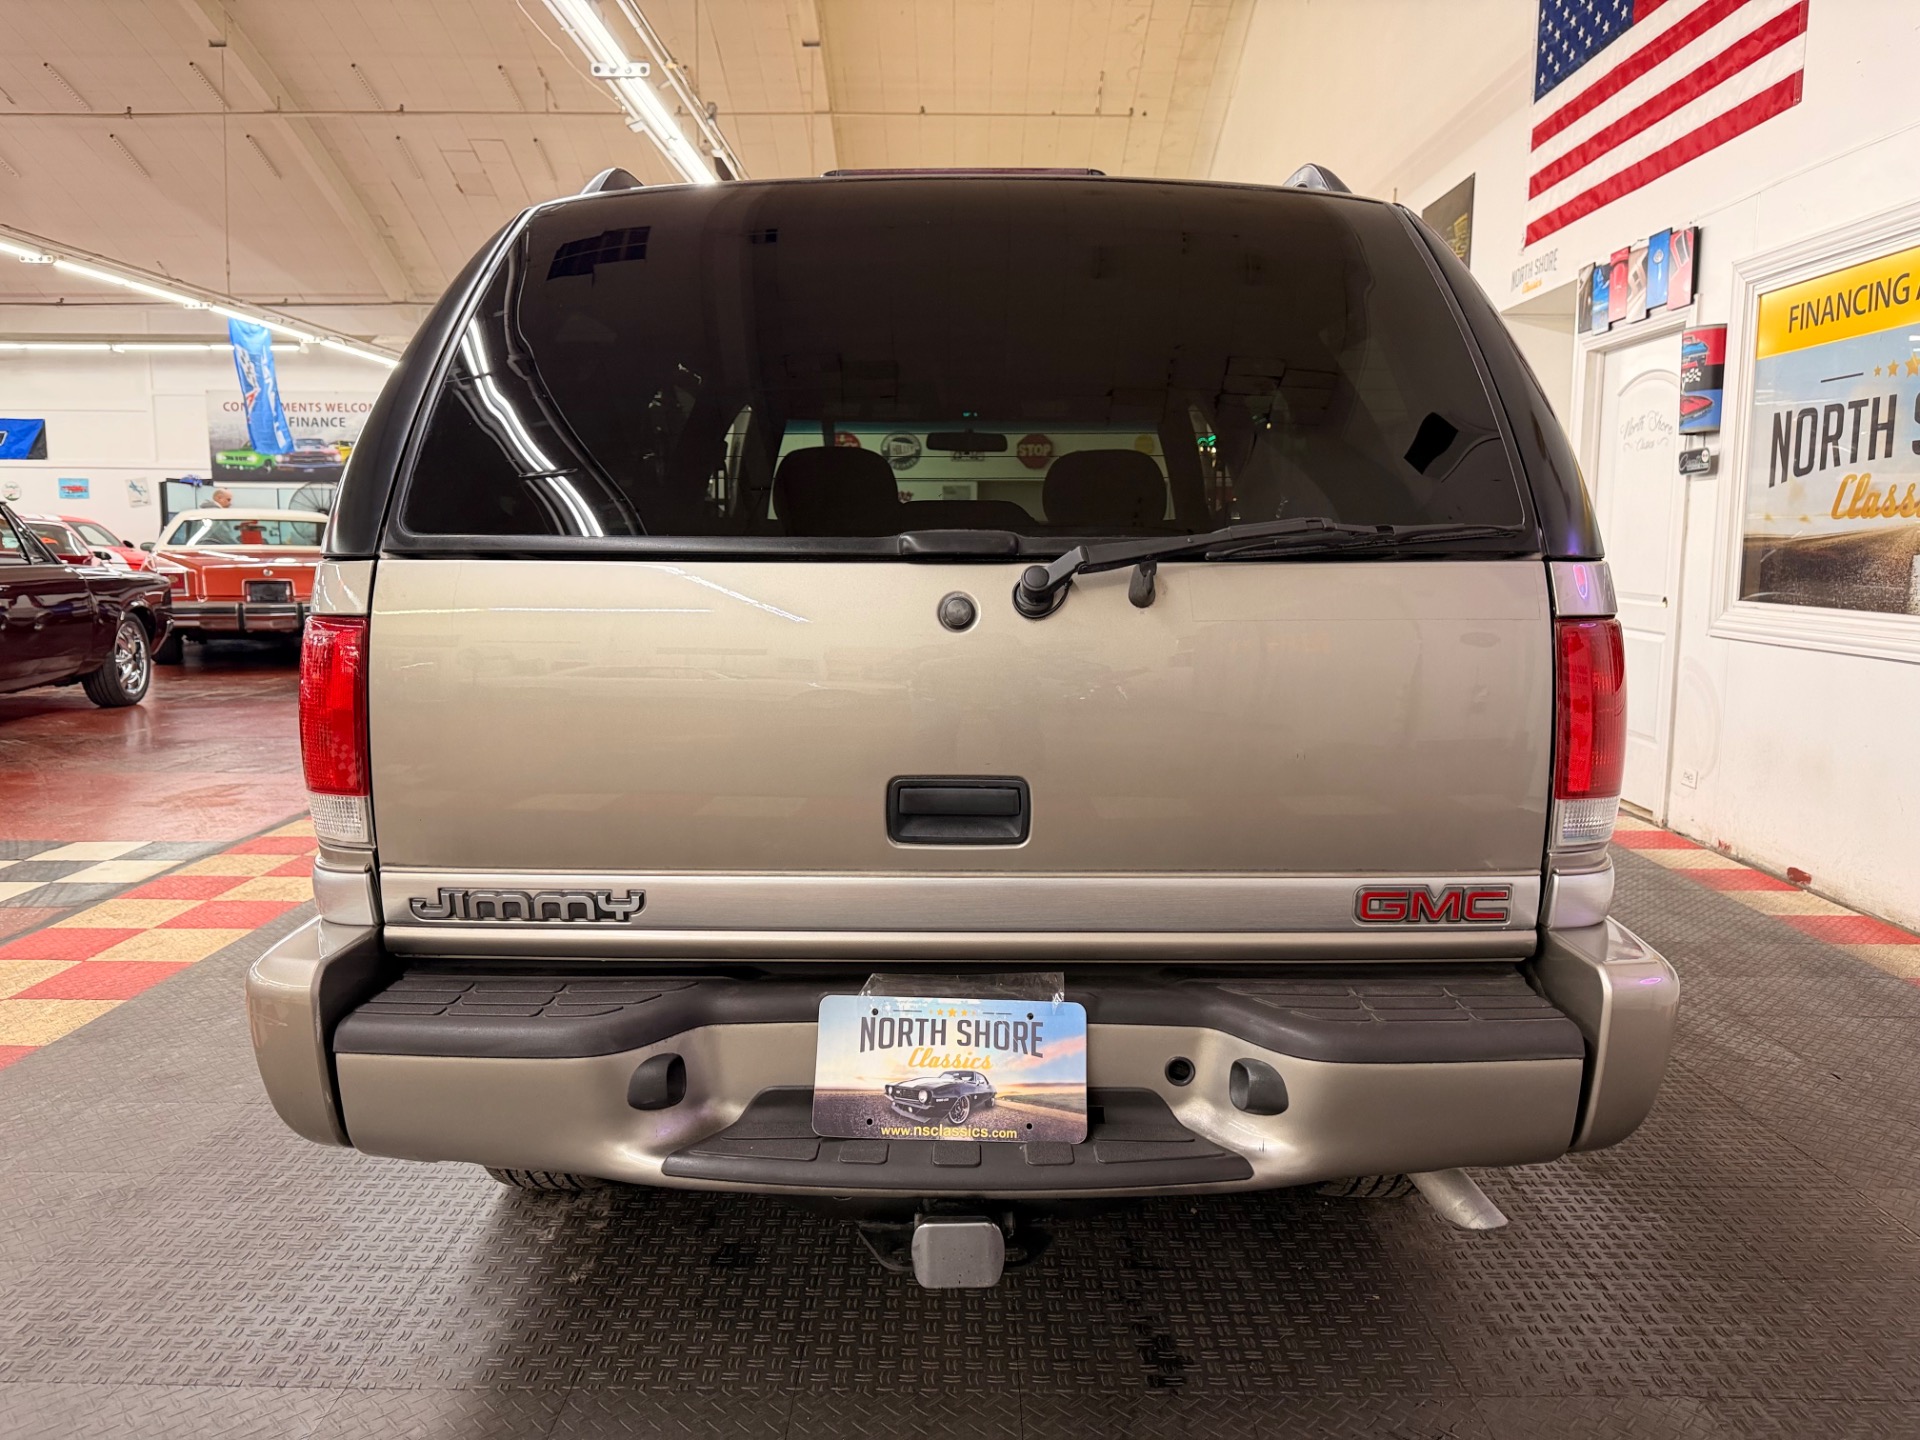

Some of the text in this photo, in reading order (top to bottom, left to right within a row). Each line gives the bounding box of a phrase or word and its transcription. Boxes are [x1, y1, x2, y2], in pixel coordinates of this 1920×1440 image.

[1788, 272, 1910, 333] FINANCING
[289, 416, 346, 428] FINANCE
[1020, 443, 1053, 456] STOP
[1768, 393, 1898, 488] NORTH
[1831, 472, 1920, 520] Class
[1358, 888, 1510, 923] GMC
[860, 1016, 1044, 1058] NORTH SHORE
[907, 1047, 992, 1070] Classics
[880, 1123, 1018, 1139] www.nsclassics.com
